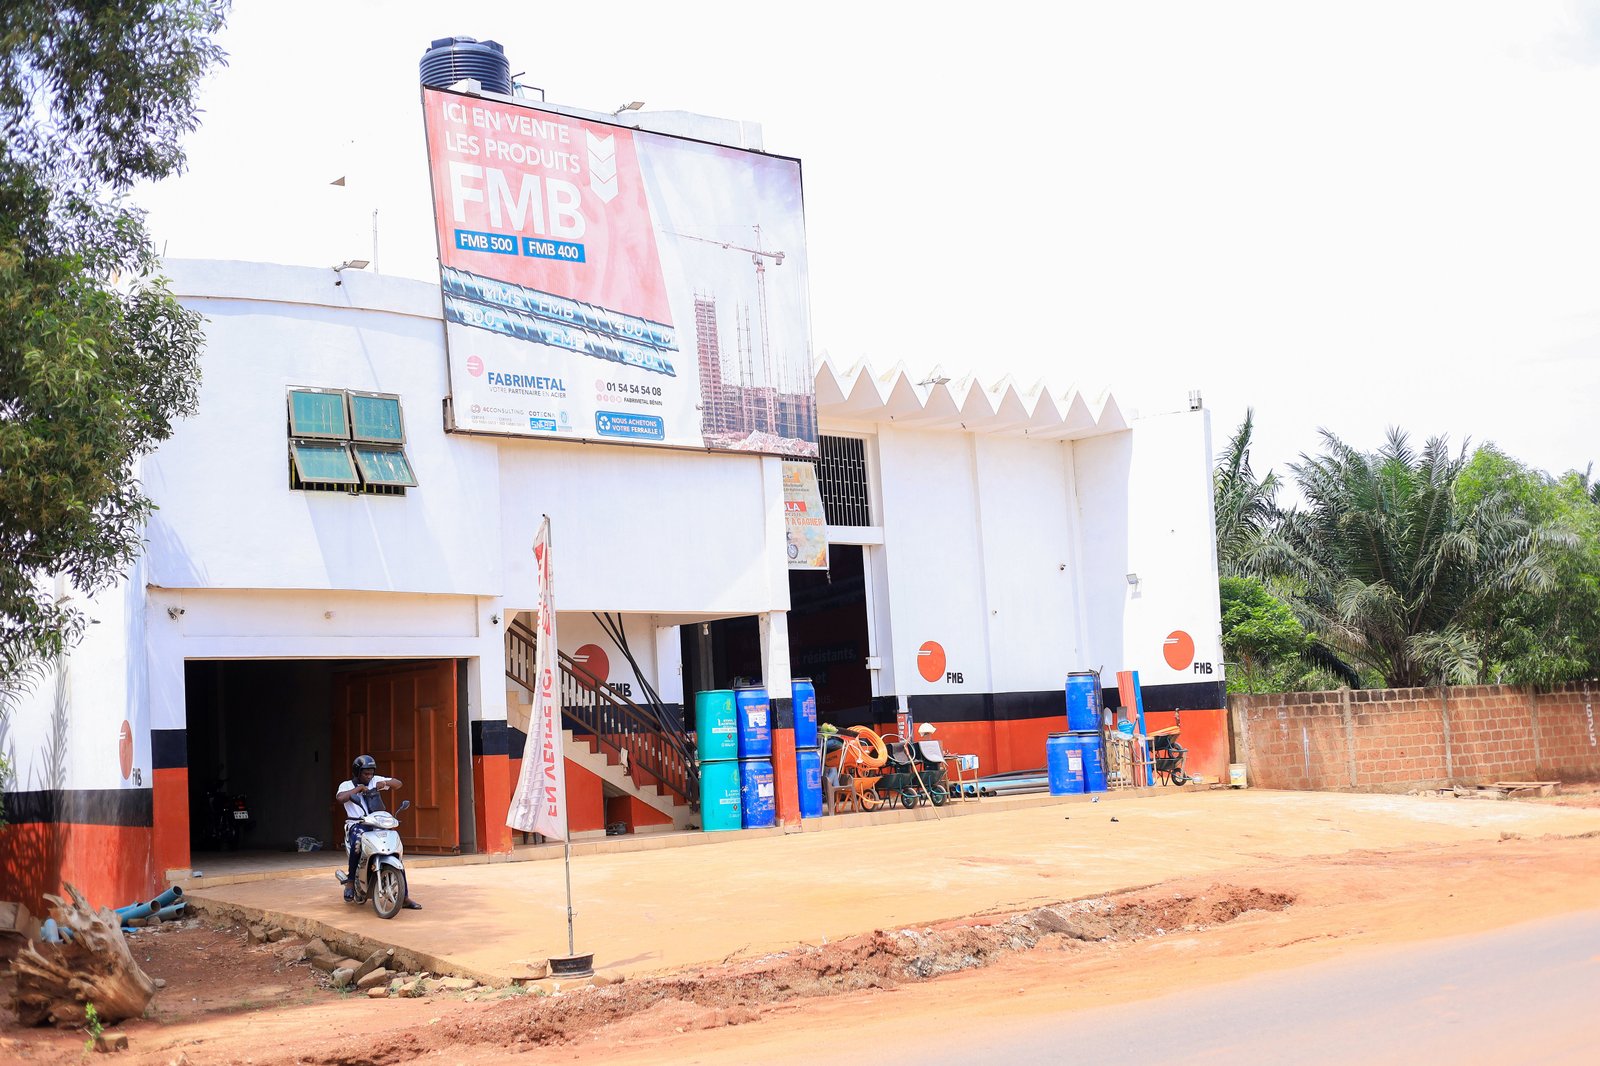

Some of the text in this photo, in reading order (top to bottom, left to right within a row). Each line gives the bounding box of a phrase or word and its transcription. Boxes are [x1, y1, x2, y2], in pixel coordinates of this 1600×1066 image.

[442, 101, 571, 144] ICI EN VENTE
[445, 131, 581, 174] LES PRODUITS
[449, 160, 586, 240] FMB
[460, 233, 514, 252] FMB 500
[529, 241, 580, 259] FMB 400
[487, 372, 566, 392] FABRIMETAL
[606, 382, 662, 397] 01 54 54 54 08
[489, 387, 508, 395] VOTRE
[508, 388, 541, 397] PARTENAIRE
[628, 419, 657, 427] ACHETONS
[631, 426, 658, 435] FERRAILLE
[1194, 662, 1213, 674] FMB
[947, 672, 964, 684] FMB
[609, 682, 632, 697] FMB
[132, 767, 142, 787] FMB
